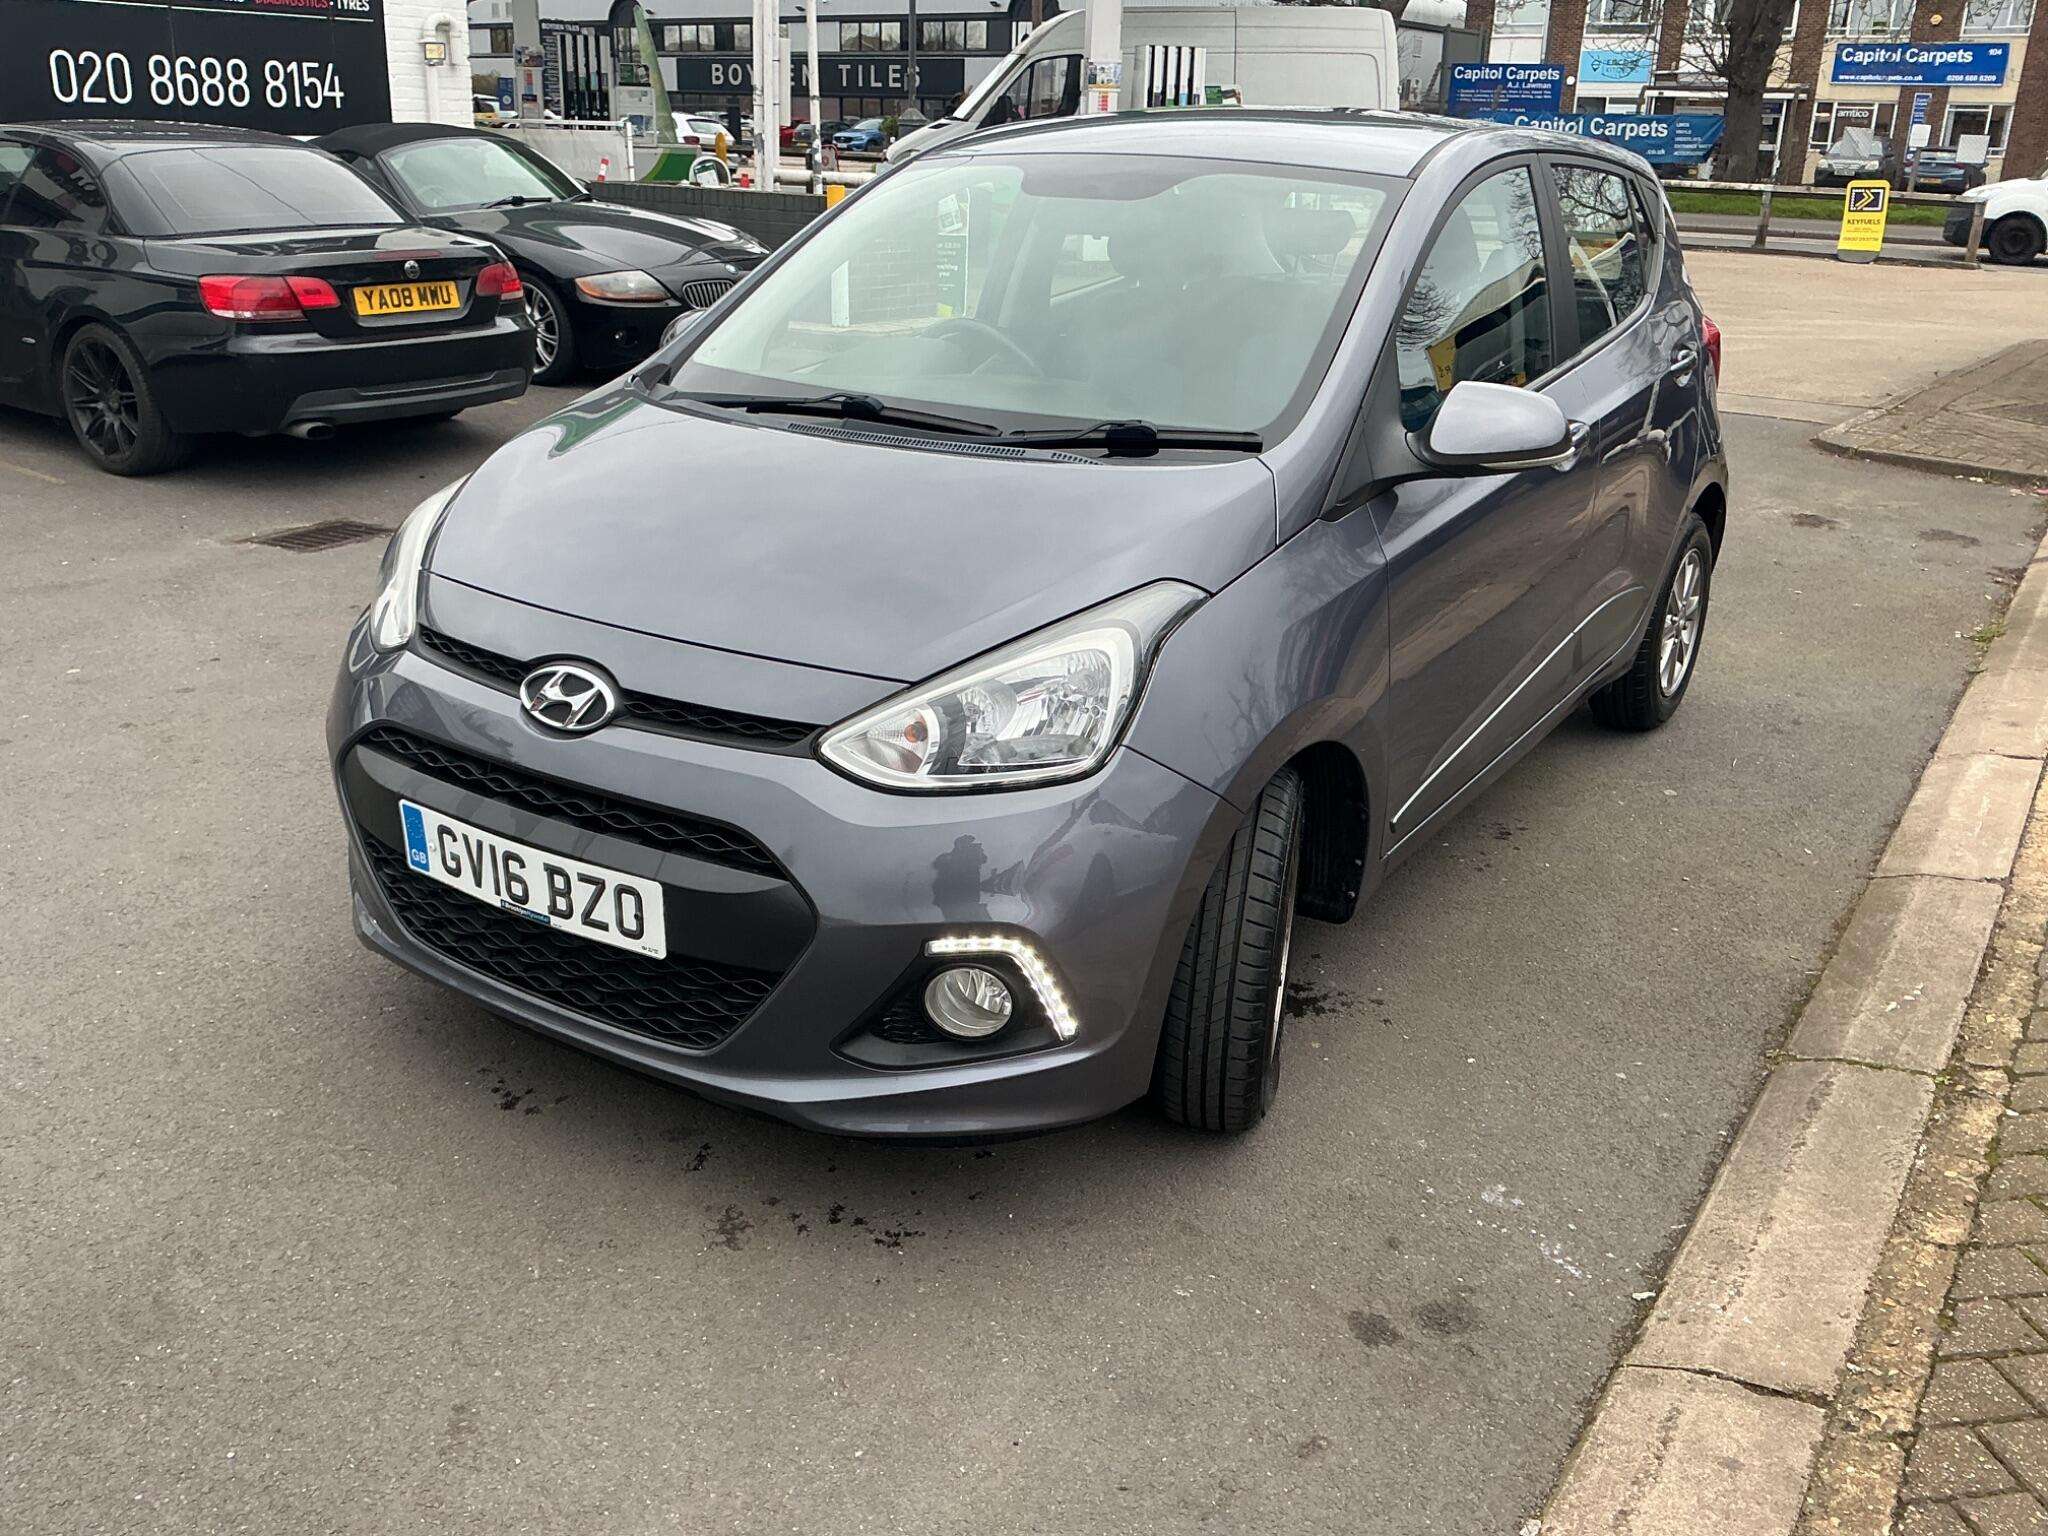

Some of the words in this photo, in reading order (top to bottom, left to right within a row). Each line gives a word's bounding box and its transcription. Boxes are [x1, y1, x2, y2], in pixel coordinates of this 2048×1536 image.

[337, 0, 370, 11] TYRES
[1841, 48, 1900, 65] Capitol
[1906, 48, 1973, 66] Carpets
[50, 49, 133, 104] 020
[148, 54, 250, 107] 8688
[264, 59, 344, 109] 8154
[838, 64, 921, 88] TILES
[1454, 66, 1503, 82] Capitol
[1506, 66, 1560, 82] Carpets
[1837, 110, 1870, 118] amtico
[1589, 117, 1669, 140] Carpets
[363, 287, 414, 310] YA08
[416, 285, 452, 307] MWU
[411, 849, 427, 865] GB
[437, 824, 529, 906] GV16
[543, 862, 645, 941] BZO
